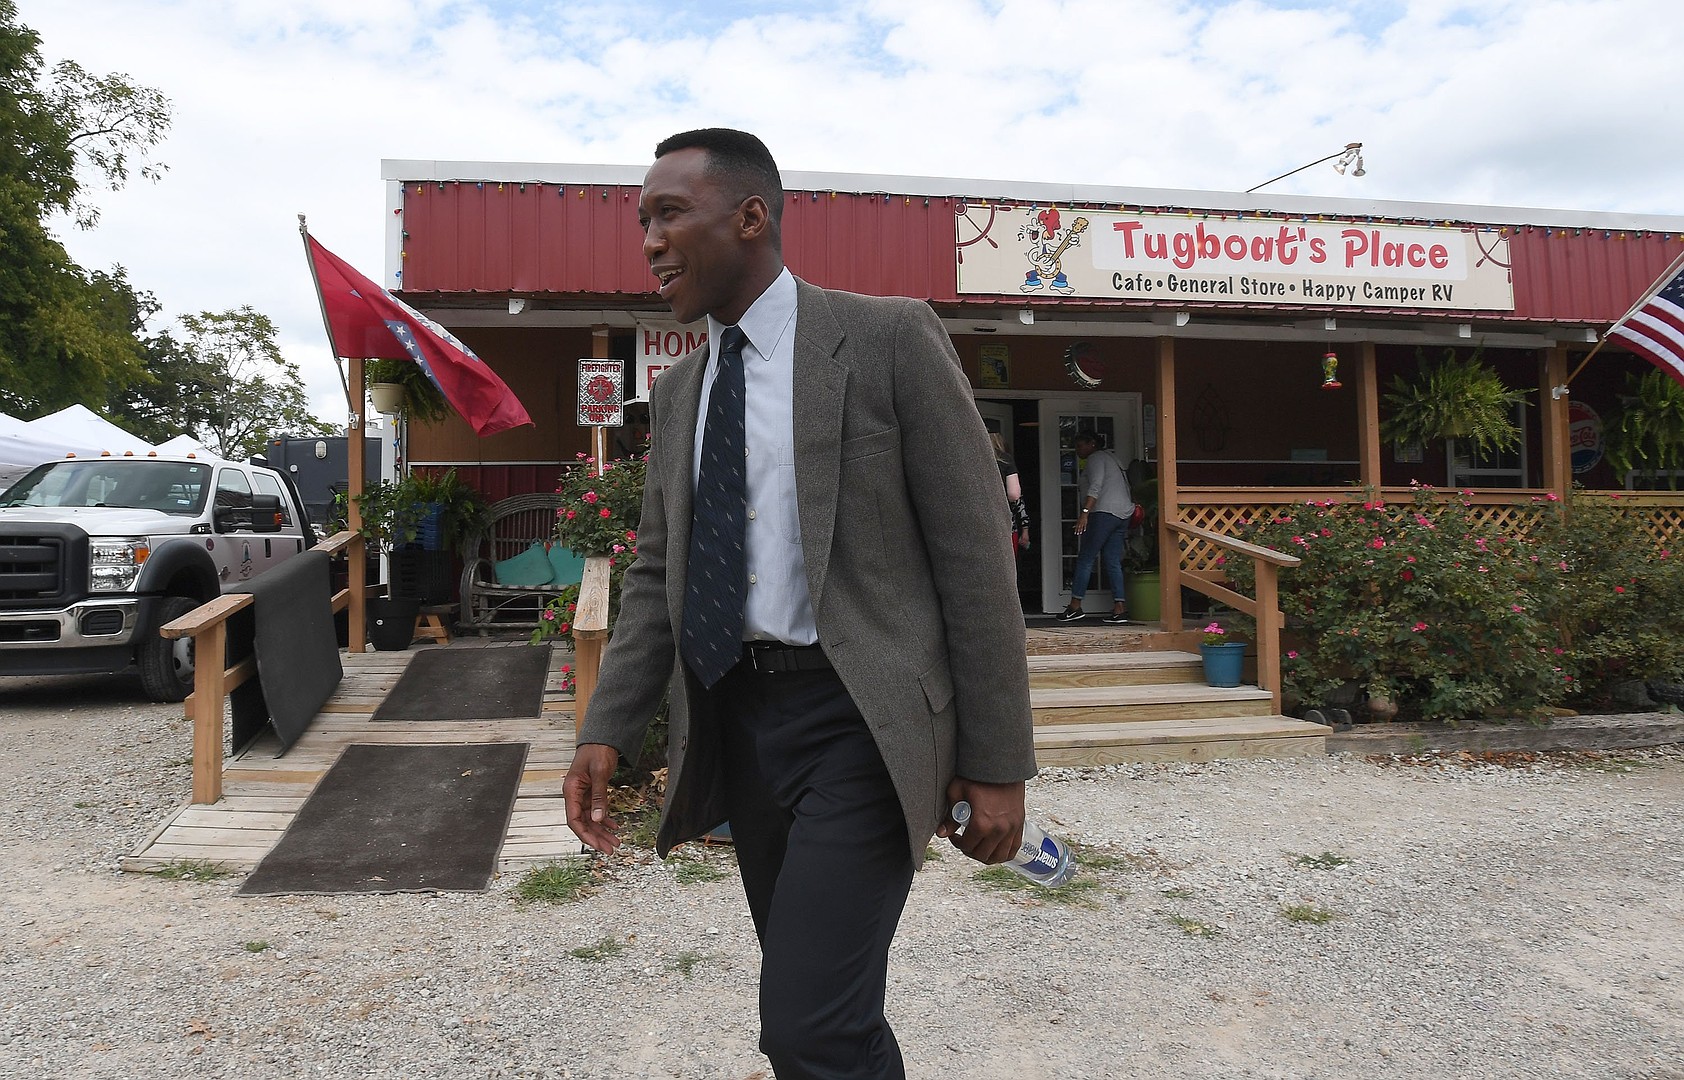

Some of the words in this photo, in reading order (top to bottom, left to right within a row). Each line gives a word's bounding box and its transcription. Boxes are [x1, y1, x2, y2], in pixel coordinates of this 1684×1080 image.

[1112, 221, 1327, 269] Tugboat's
[1341, 229, 1449, 269] Place
[1112, 272, 1152, 292] Cafe
[1167, 273, 1234, 295] General
[1240, 276, 1285, 296] Store
[1302, 279, 1356, 301] Happy
[1363, 281, 1426, 303] Camper
[1432, 283, 1453, 302] RV
[581, 363, 621, 373] FIREFIGHTER
[581, 404, 620, 413] PARKING
[588, 413, 612, 422] ONLY
